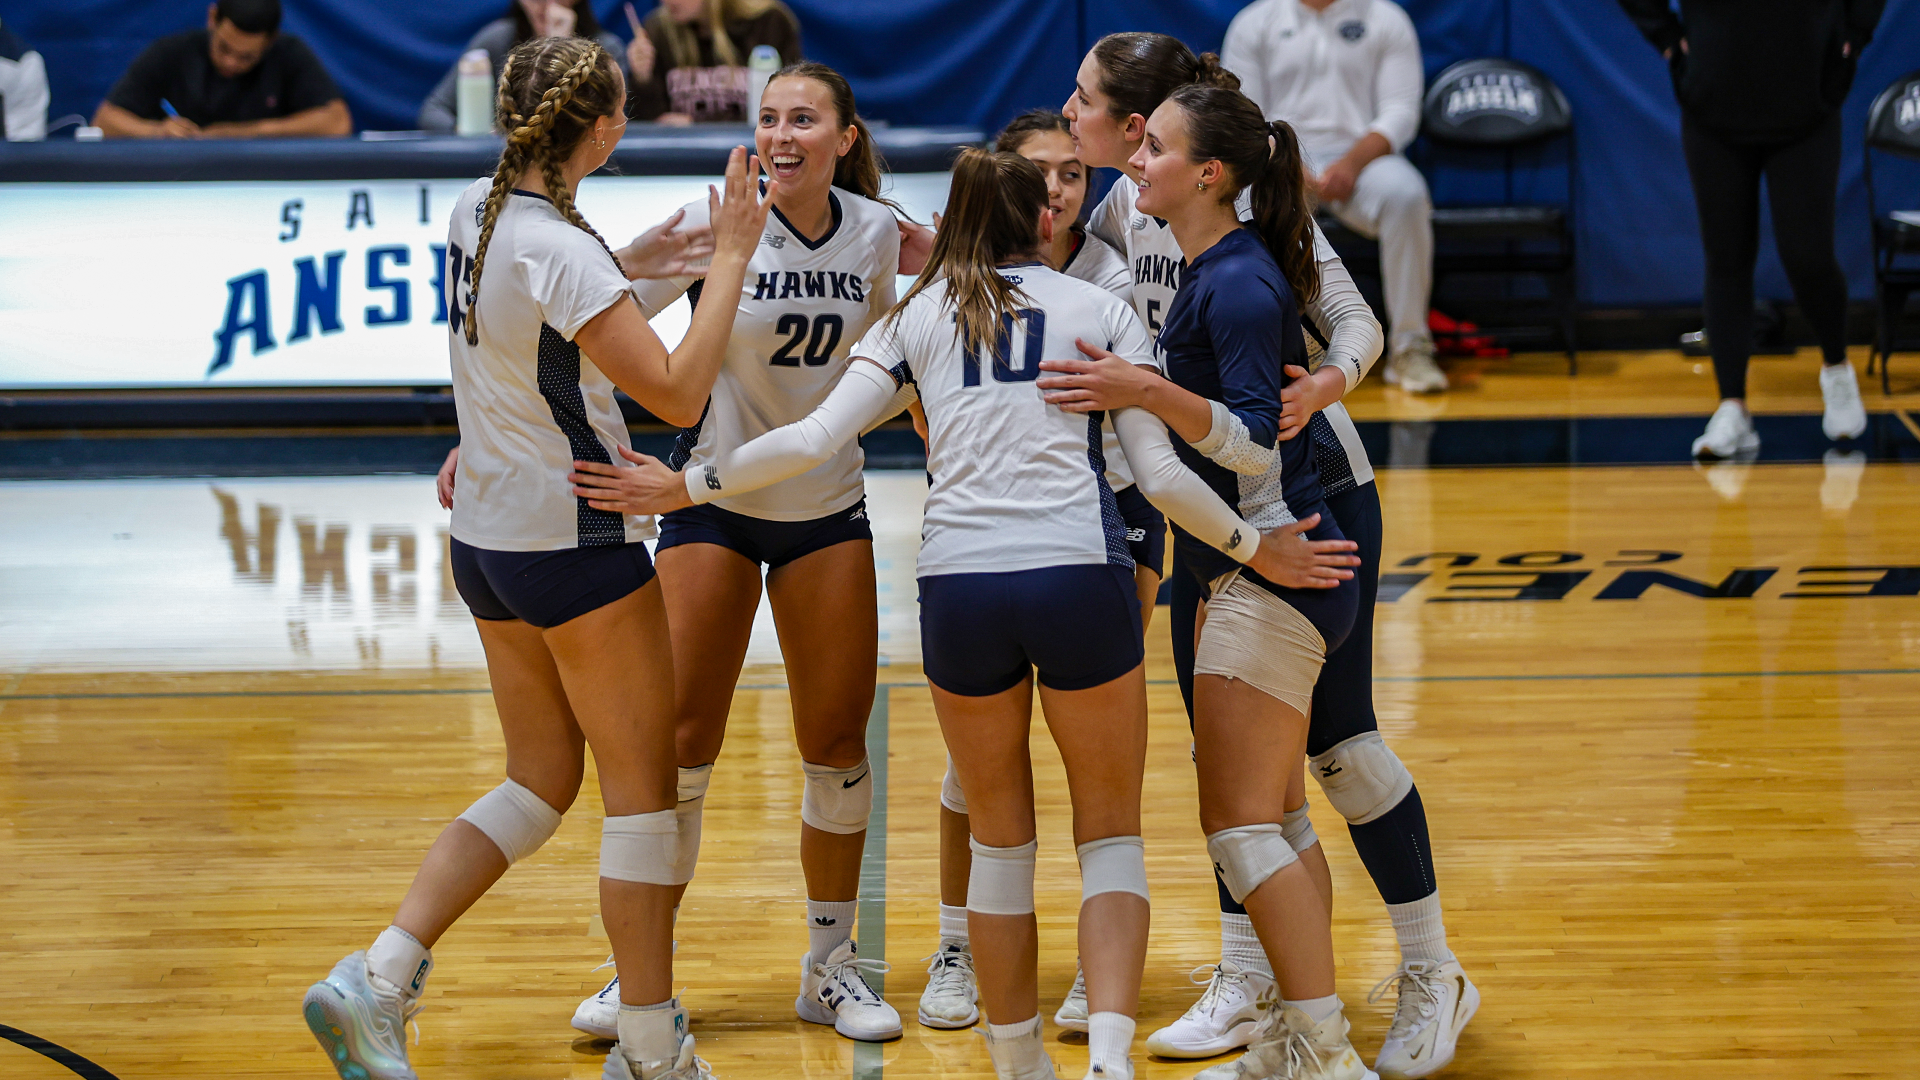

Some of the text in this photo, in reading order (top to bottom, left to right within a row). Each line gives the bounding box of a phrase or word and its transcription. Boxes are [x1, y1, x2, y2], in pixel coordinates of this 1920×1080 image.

[752, 270, 865, 303] HAWKS
[769, 312, 845, 368] 20
[951, 307, 1047, 389] 10
